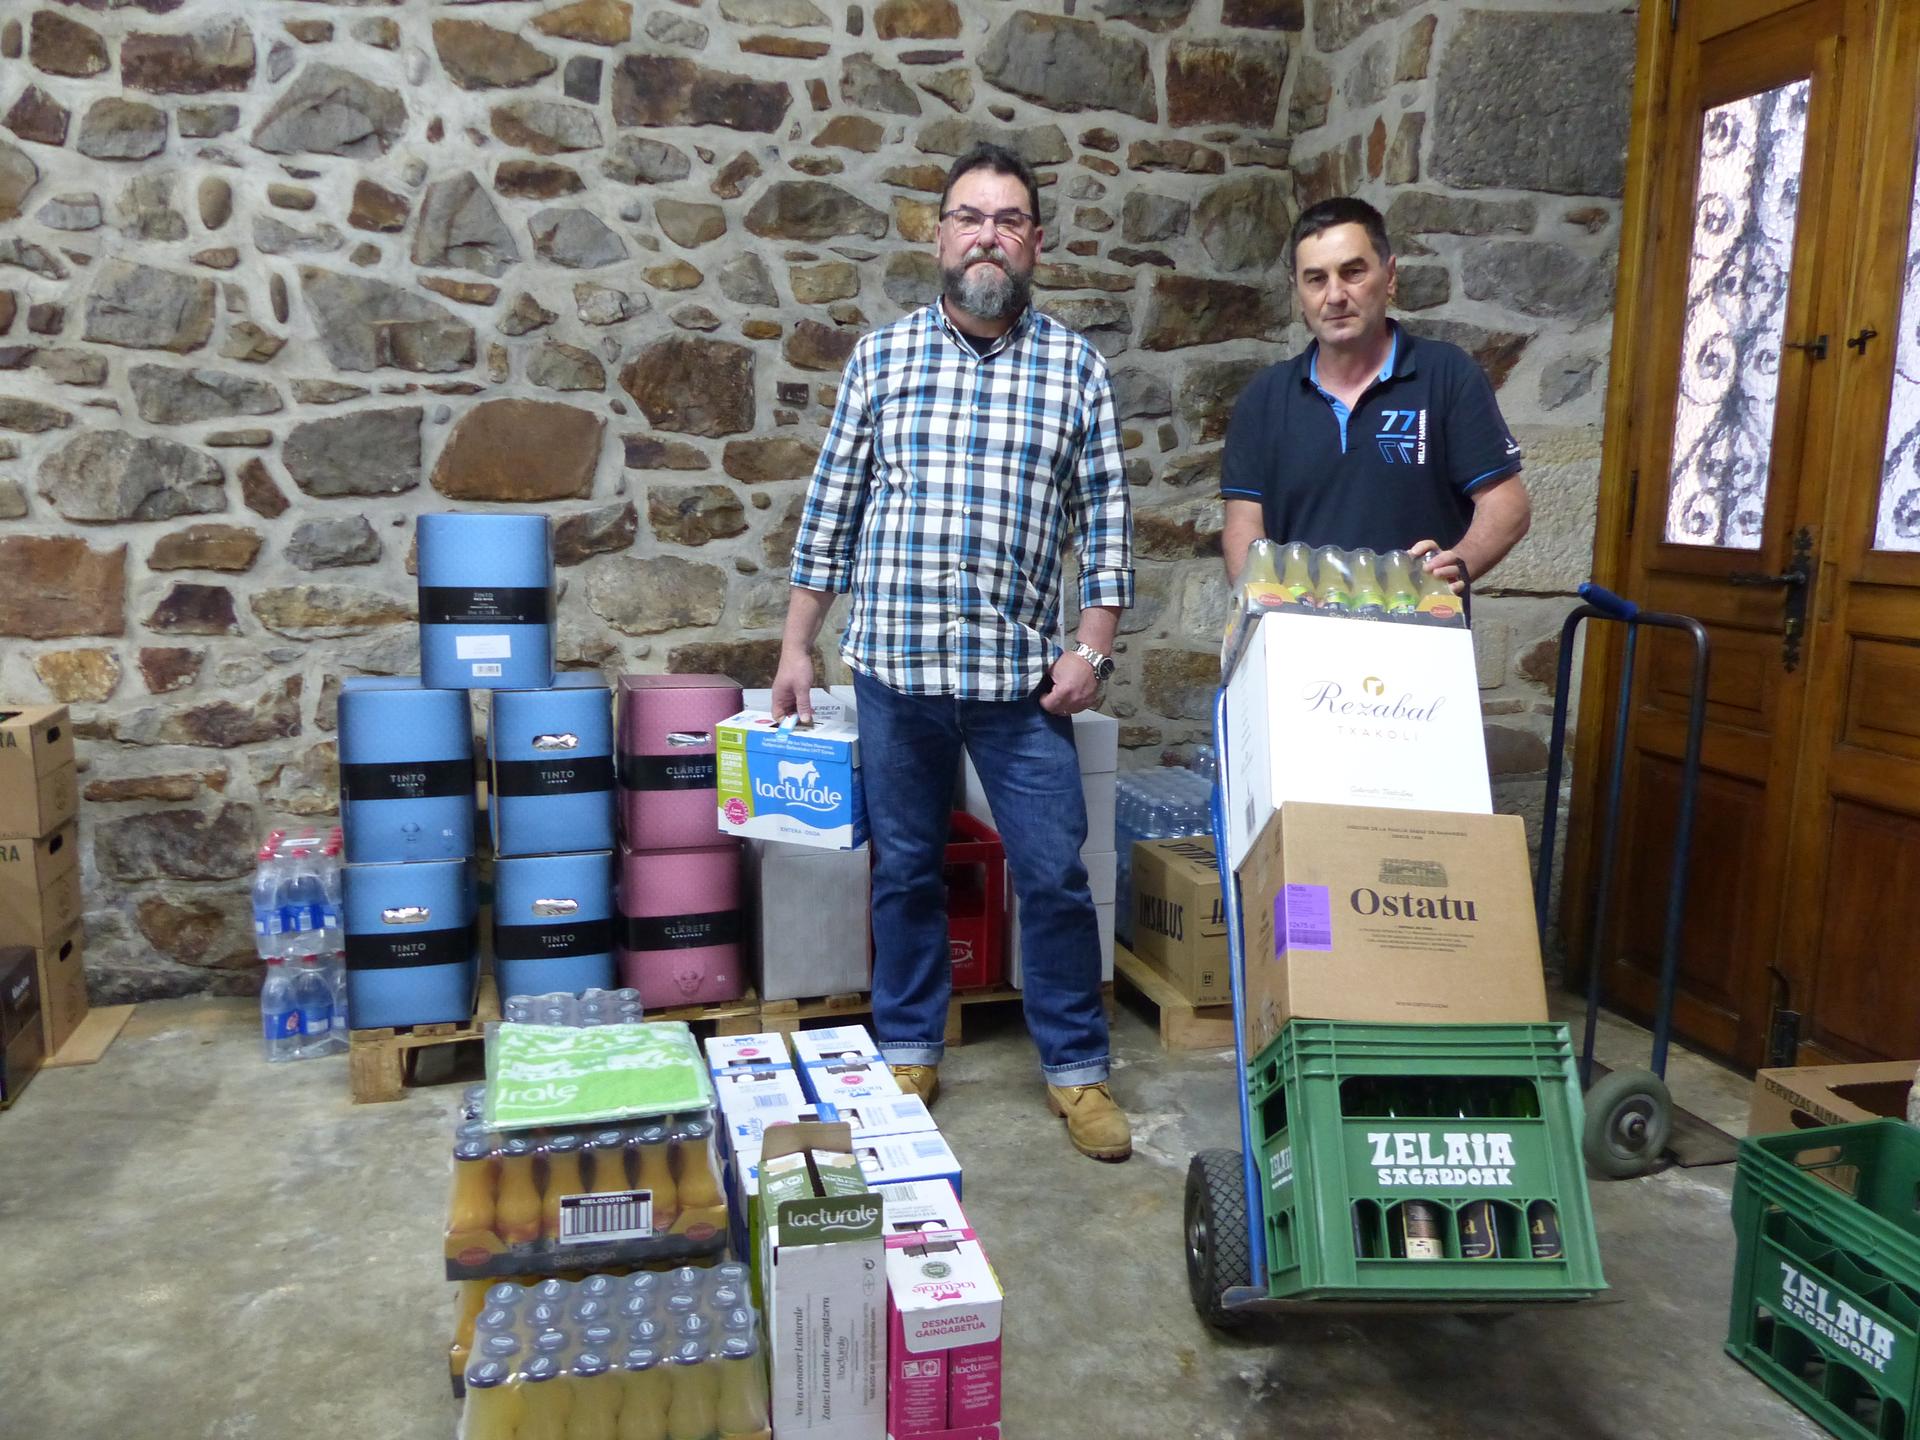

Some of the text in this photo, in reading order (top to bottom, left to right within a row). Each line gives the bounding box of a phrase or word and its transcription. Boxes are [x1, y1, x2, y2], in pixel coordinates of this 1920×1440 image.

[1381, 410, 1417, 432] 77
[1417, 409, 1427, 465] HELLY HANSEN
[1304, 680, 1446, 723] Rezabal
[1336, 725, 1419, 742] TXAKOLI
[389, 773, 427, 783] TINTO
[540, 770, 576, 780] TINTO
[665, 765, 713, 775] CLARETE
[754, 777, 842, 805] lacturale
[1350, 887, 1479, 922] Ostatu
[1139, 893, 1185, 942] INSALUS
[540, 933, 576, 944] TINTO
[664, 923, 713, 936] CLARETE
[388, 942, 428, 953] TINTO
[1377, 1167, 1513, 1186] SAGARDOAK
[787, 1204, 879, 1228] lacturale
[915, 1321, 987, 1338] GAINGABETUA
[921, 1314, 980, 1329] DESNATADA
[1781, 1294, 1886, 1374] SAGARDOAK
